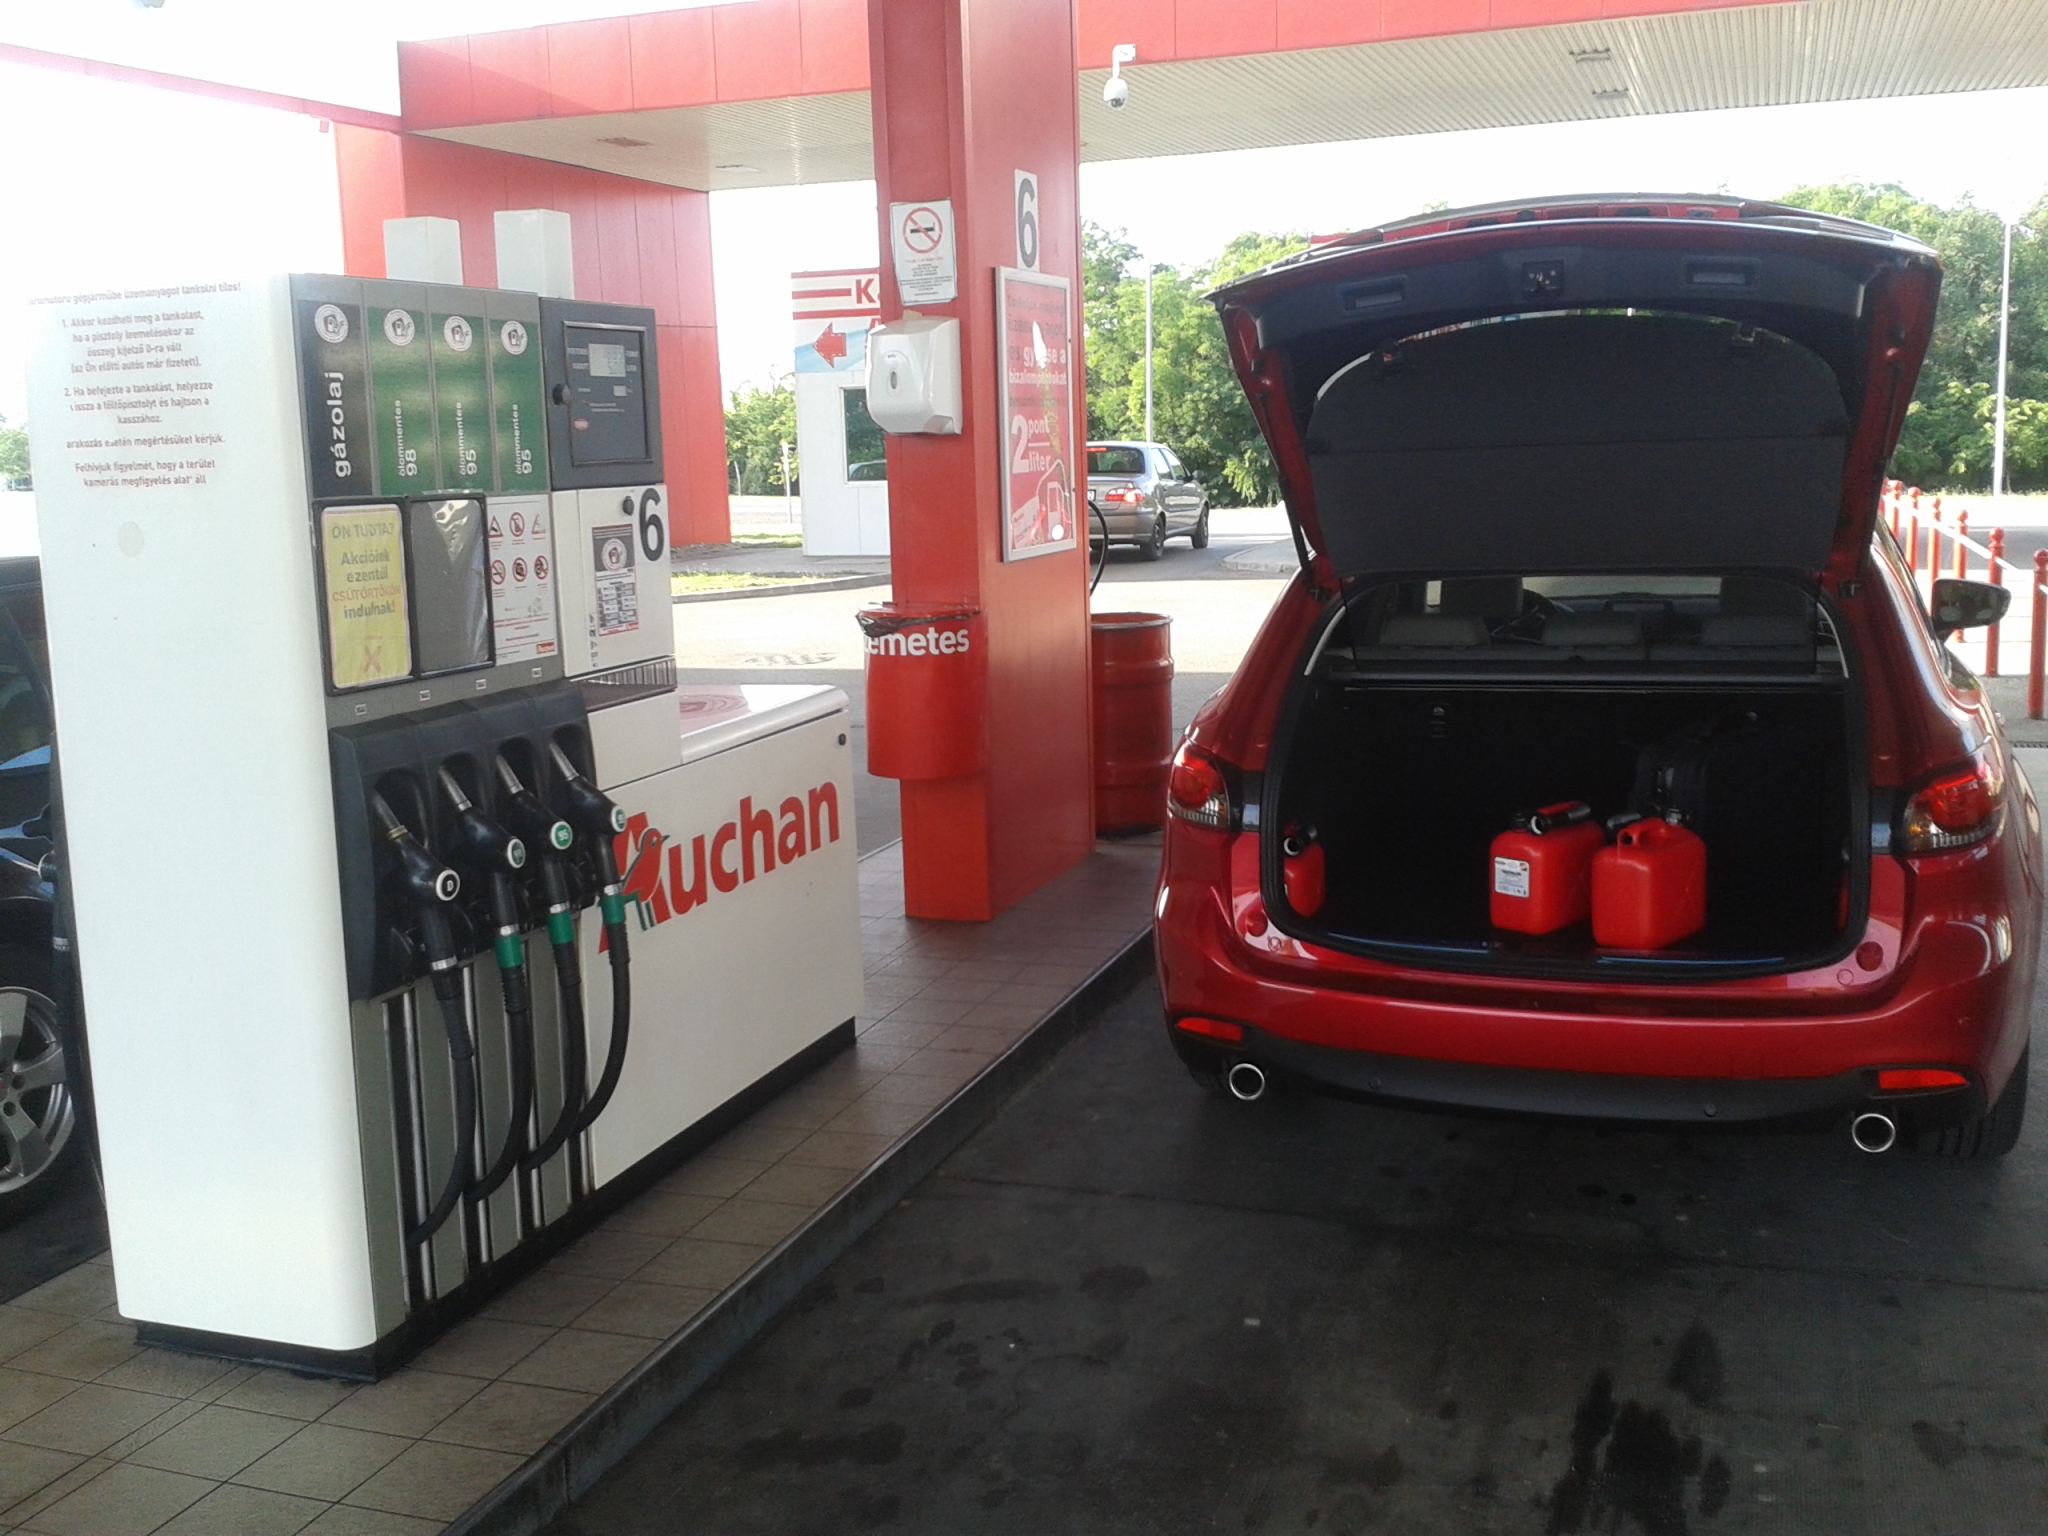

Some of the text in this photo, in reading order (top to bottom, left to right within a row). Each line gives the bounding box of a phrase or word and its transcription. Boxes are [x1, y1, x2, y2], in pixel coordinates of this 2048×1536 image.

[1018, 178, 1036, 268] 6
[181, 282, 217, 294] tankolni
[219, 281, 241, 292] tilos!
[71, 317, 95, 327] Akkor
[97, 314, 132, 325] kezdheti
[134, 314, 153, 325] meg
[73, 327, 195, 343] ha a pisztoly leemelésekor az
[87, 342, 182, 358] összeg kijelző 0-ra vált
[85, 359, 96, 372] Ön
[98, 359, 120, 371] előtti
[121, 358, 144, 370] autós
[147, 357, 163, 369] már
[64, 387, 72, 397] 2.
[73, 386, 85, 397] Ha
[87, 384, 123, 397] befejezte
[132, 381, 175, 394] tankolást,
[176, 380, 213, 393] helyezze
[103, 398, 157, 411] töltőpisztolyt
[159, 396, 169, 407] és
[170, 396, 202, 408] hajtson
[117, 413, 163, 424] kasszához.
[324, 372, 352, 478] gázolaj
[1028, 416, 1050, 439] pont
[134, 434, 193, 447] megértésüket
[195, 432, 226, 446] kérjük.
[1011, 414, 1030, 474] 2
[75, 461, 111, 473] Felhívjuk
[113, 459, 155, 473] figyelmét,
[156, 460, 176, 472] hogy
[186, 458, 215, 469] terület
[404, 449, 418, 476] 98
[466, 449, 478, 475] 95
[521, 449, 533, 475] 95
[1029, 451, 1051, 473] liter
[83, 475, 119, 486] kamerás
[121, 474, 171, 487] megfigyelés
[195, 474, 207, 485] áll
[332, 522, 395, 540] ÖN TUDTA?
[639, 488, 664, 561] 6
[341, 549, 391, 566] Akcióink
[347, 566, 388, 583] ezentúl
[344, 601, 396, 619] indulnak!
[865, 626, 969, 656] emetes
[557, 829, 569, 841] 95
[446, 880, 454, 892] D
